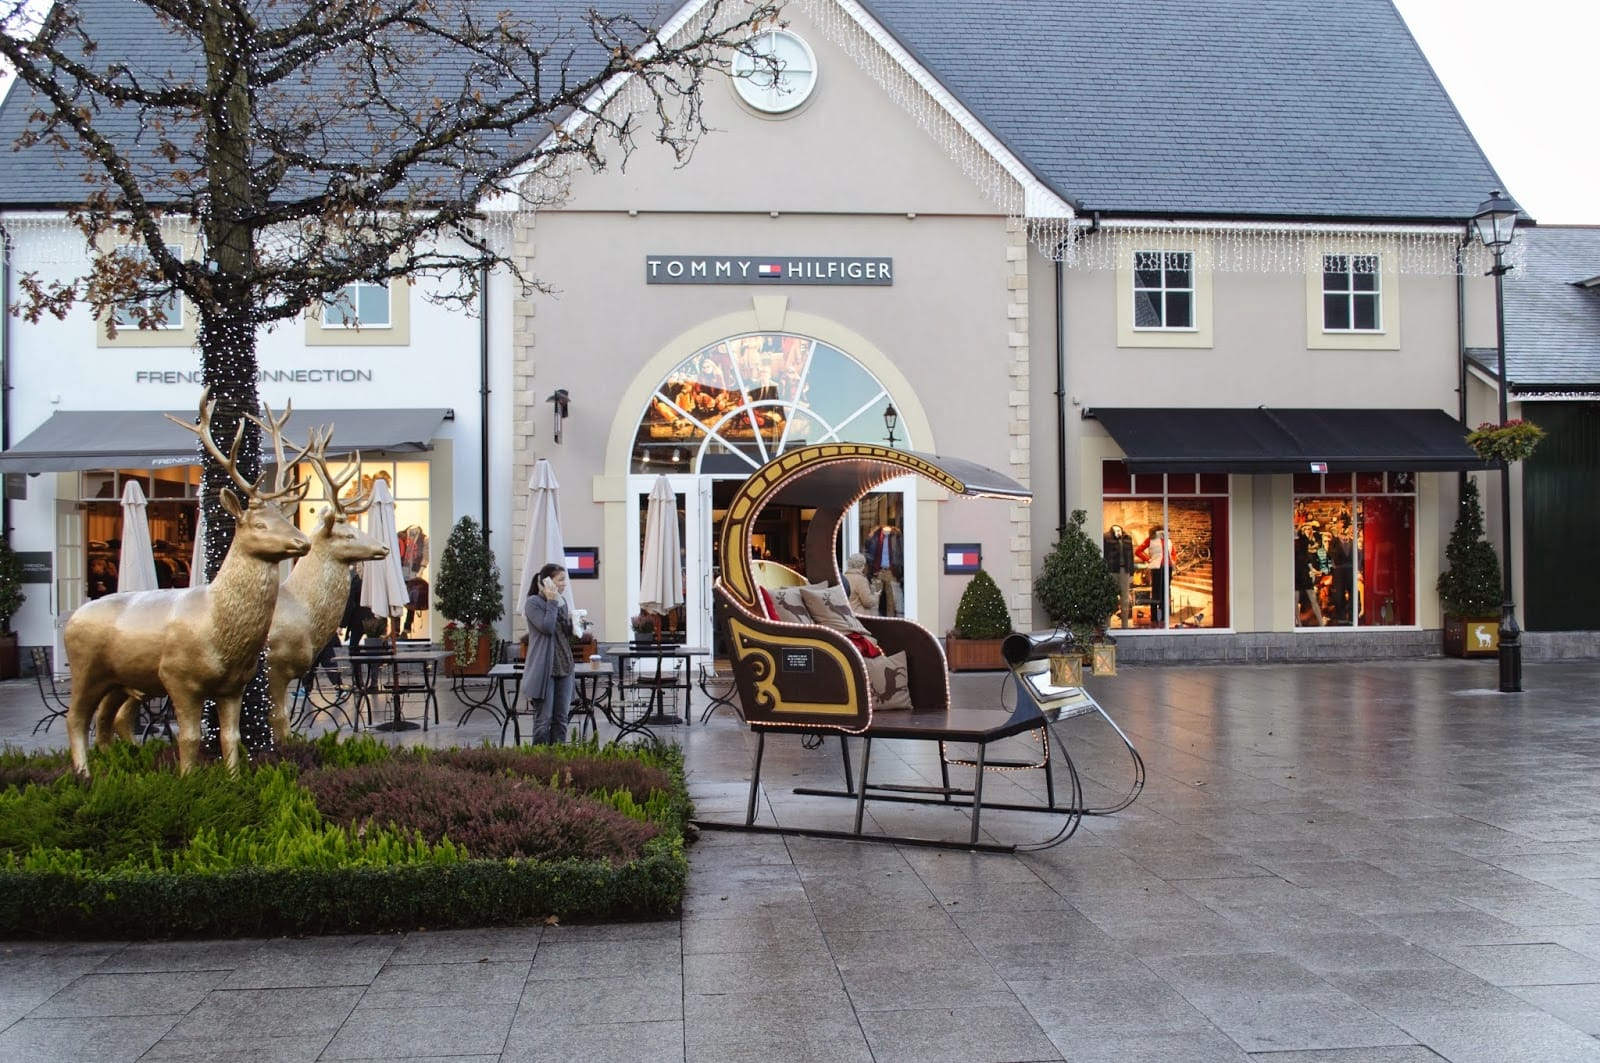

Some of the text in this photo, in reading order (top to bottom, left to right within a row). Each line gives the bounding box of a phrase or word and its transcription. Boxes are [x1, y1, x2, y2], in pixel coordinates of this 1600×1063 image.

[648, 261, 891, 279] TOMMY HILFIGER
[136, 369, 372, 384] FRENC NNECTION
